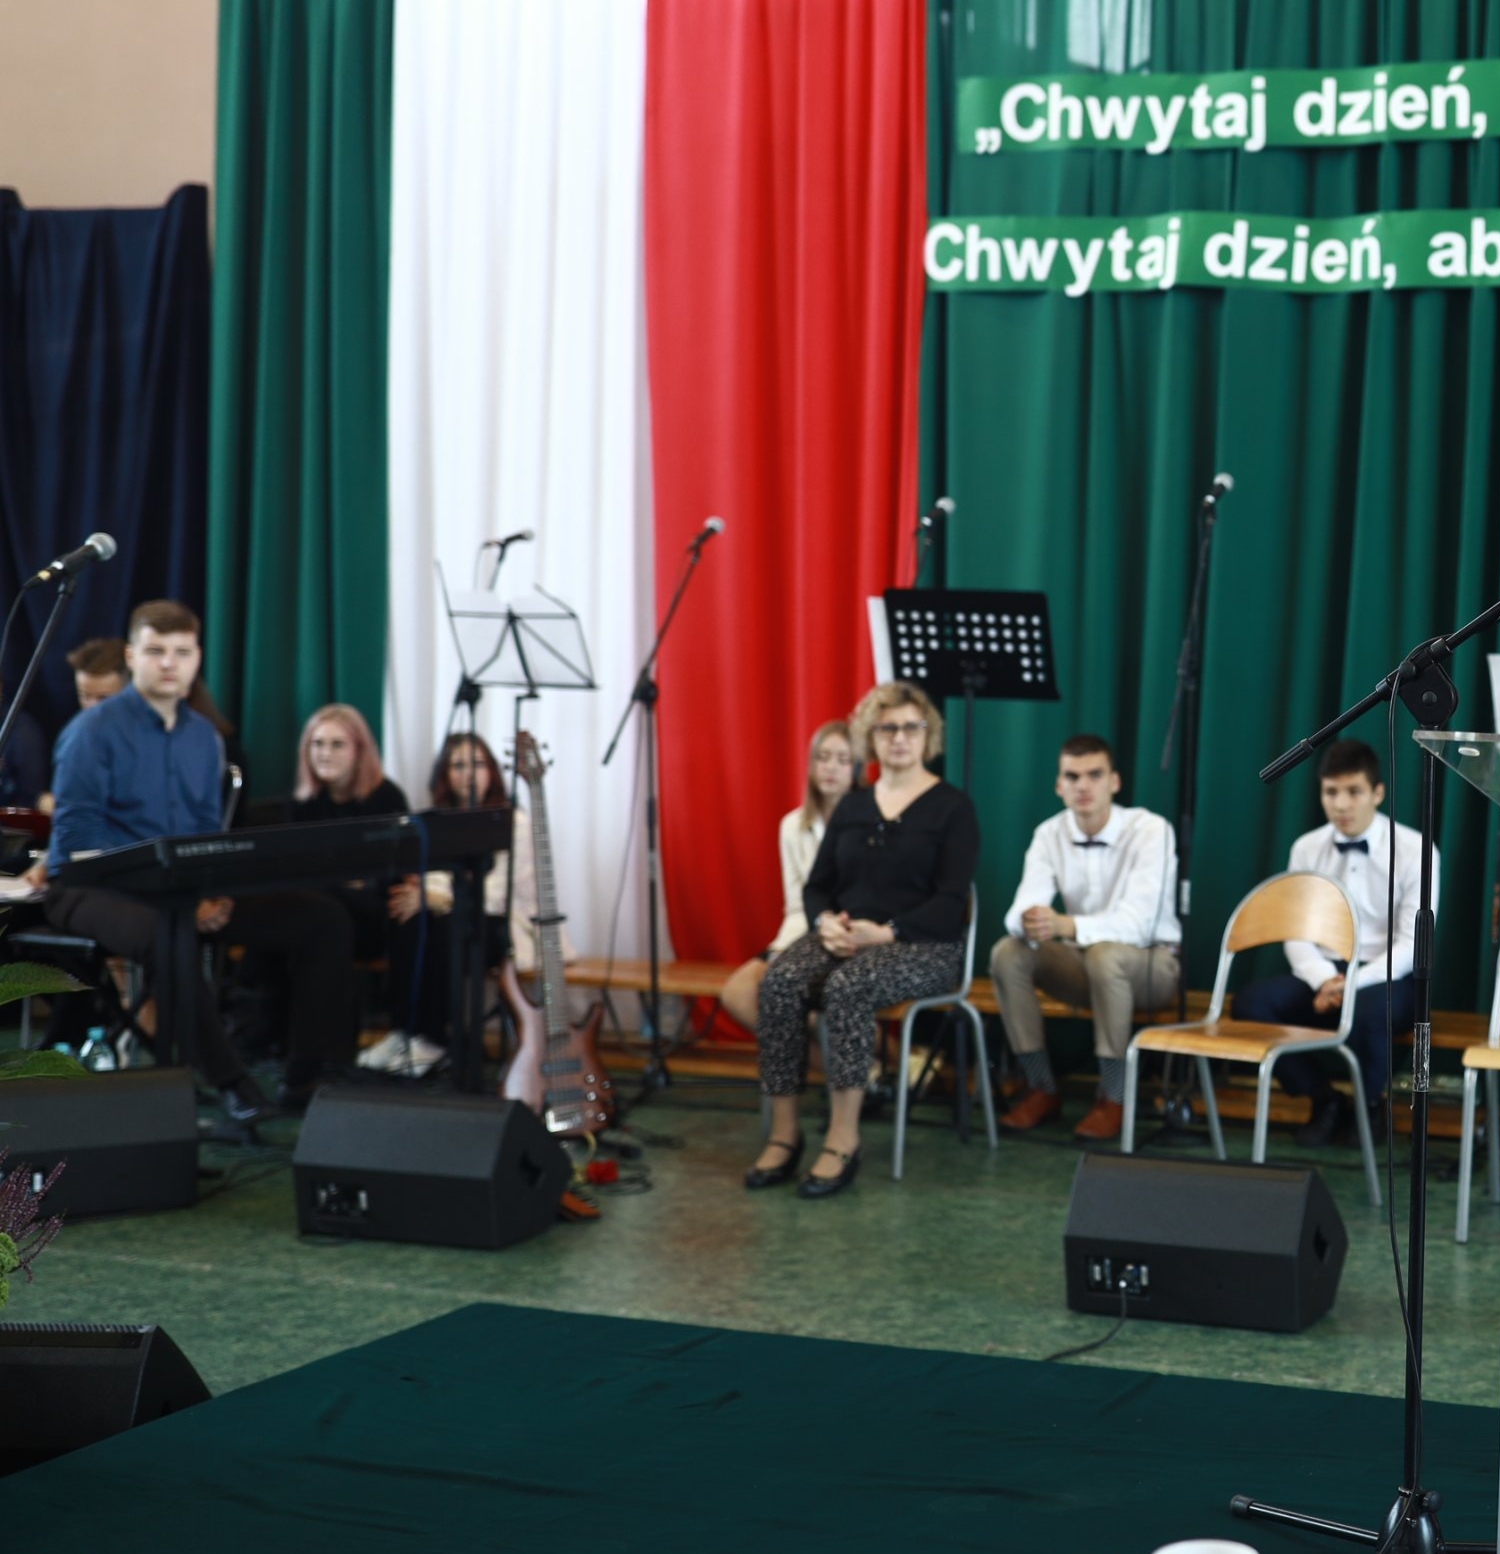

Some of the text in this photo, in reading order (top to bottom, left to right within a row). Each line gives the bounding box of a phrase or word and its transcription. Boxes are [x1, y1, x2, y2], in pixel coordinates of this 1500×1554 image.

[974, 75, 1268, 155] „Chwytaj
[1292, 65, 1488, 140] dzień,
[922, 216, 1183, 298] Chwytaj
[1202, 217, 1398, 290] dzień,
